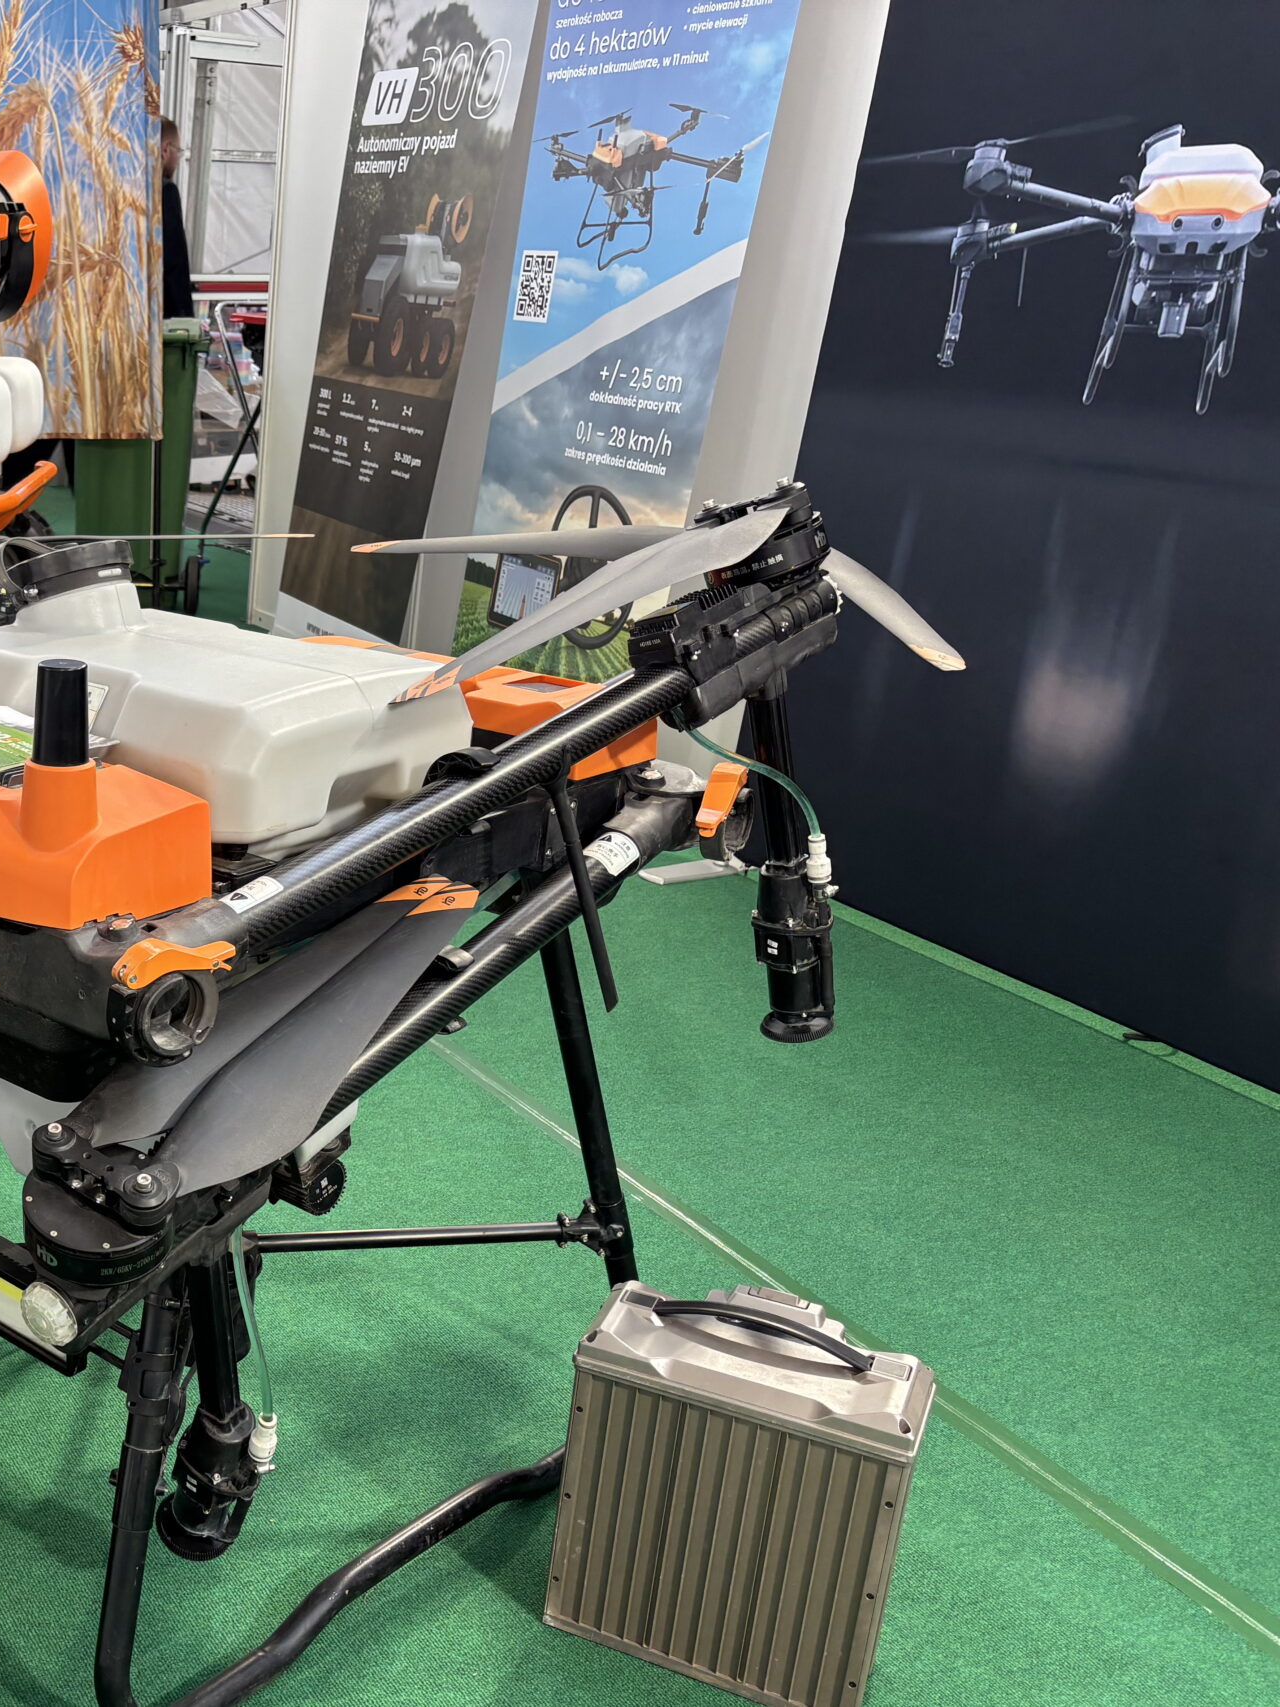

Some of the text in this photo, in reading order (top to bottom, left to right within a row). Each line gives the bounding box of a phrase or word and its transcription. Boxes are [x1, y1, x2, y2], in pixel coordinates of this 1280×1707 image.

[555, 9, 623, 29] szerokość robocza
[688, 14, 749, 34] mycie elewacji
[550, 21, 672, 60] do 4 hektarów
[410, 38, 512, 123] 300
[547, 64, 587, 83] wydajność
[587, 65, 598, 75] na
[662, 57, 670, 67] w
[680, 51, 710, 65] minut
[374, 78, 408, 116] VH
[357, 128, 458, 156] Autonomiczny pojazd
[354, 156, 410, 178] naziemny EV
[629, 366, 652, 392] 2,5
[656, 373, 683, 394] cm
[589, 390, 682, 416] dokładność pracy RTK
[576, 420, 593, 445] 0,1
[608, 426, 627, 449] 28
[628, 426, 672, 459] km/h
[565, 447, 667, 477] zakres prędkości działania
